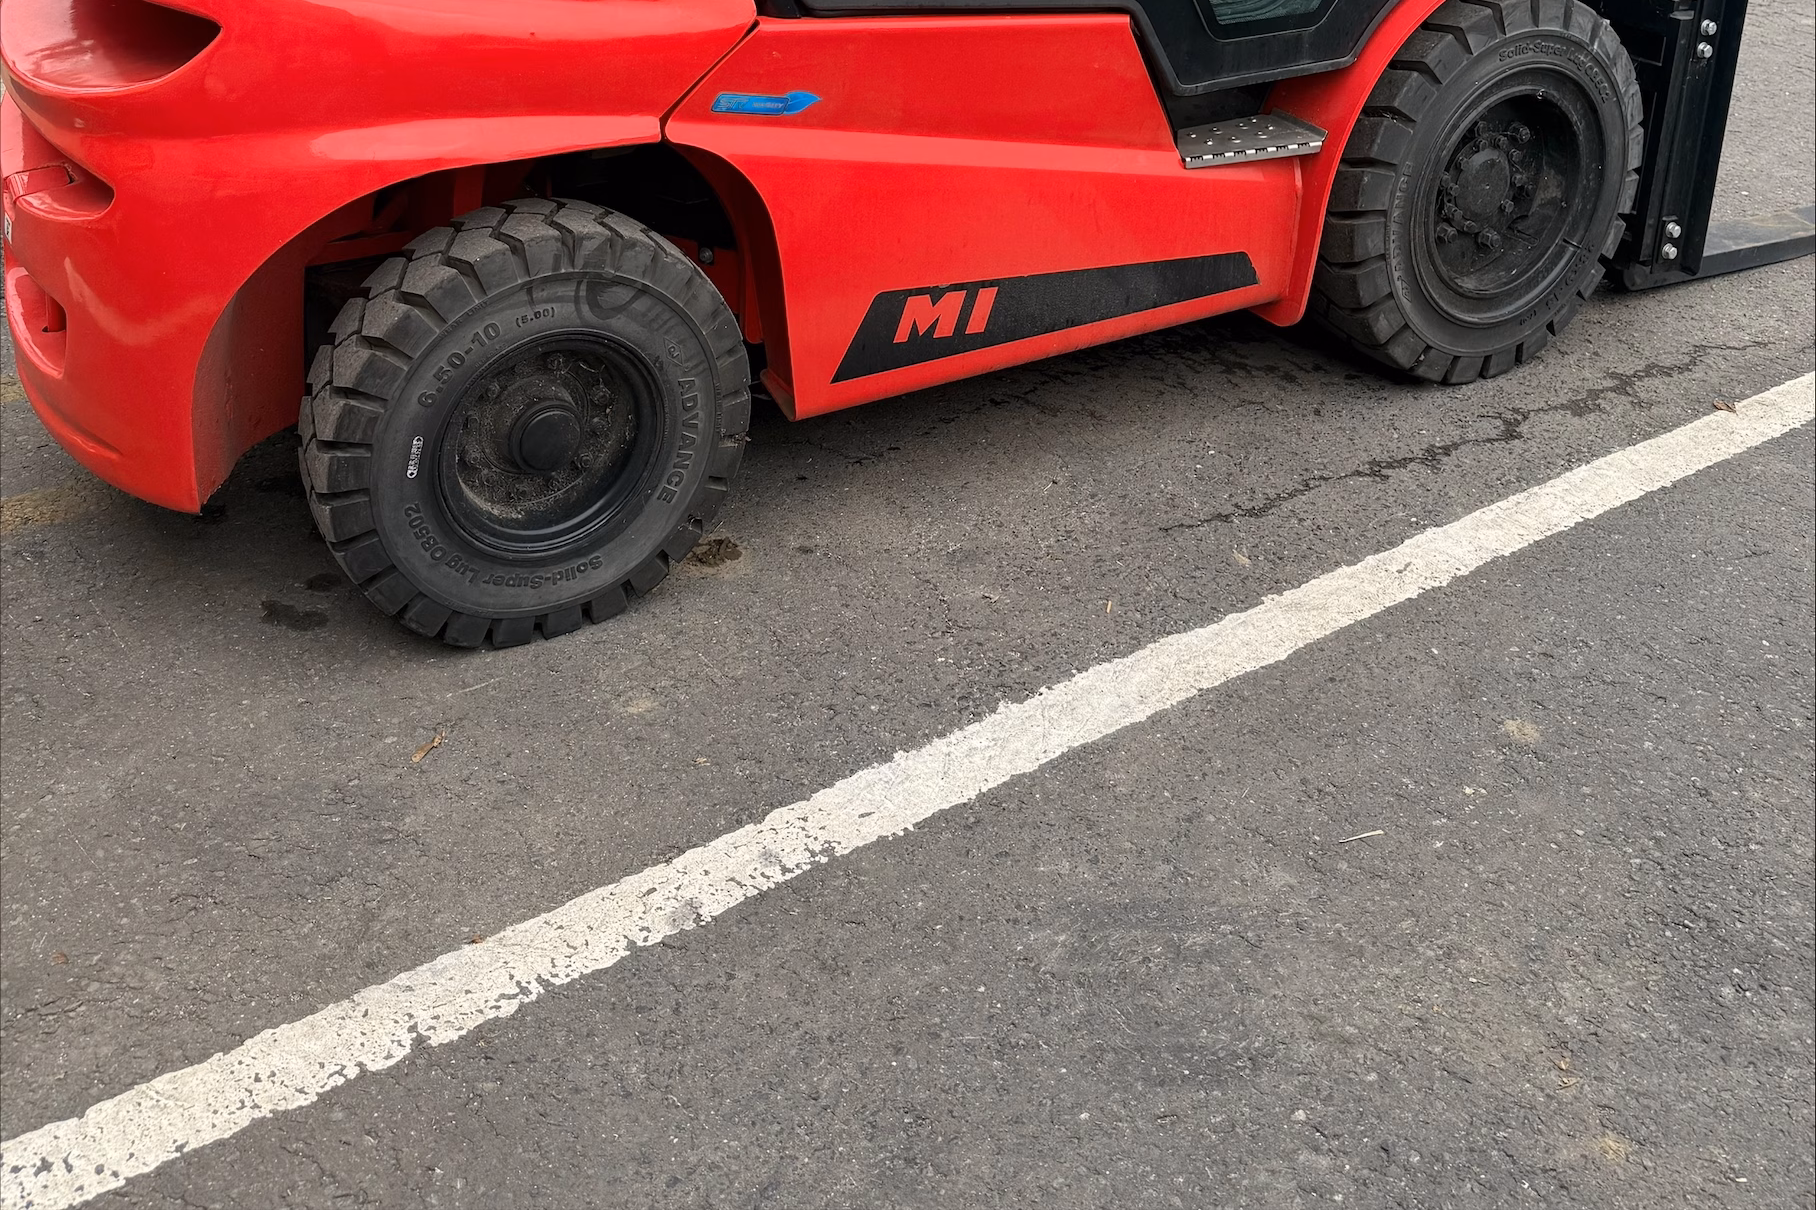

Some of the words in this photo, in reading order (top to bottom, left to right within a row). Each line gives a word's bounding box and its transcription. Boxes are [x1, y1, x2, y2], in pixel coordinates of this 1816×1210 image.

[893, 287, 998, 343] MI
[417, 320, 501, 409] 6.50-10
[514, 306, 556, 328] (5.00)
[656, 377, 700, 504] ADVANCE
[444, 554, 481, 586] Lug
[482, 554, 603, 590] Solid-Super
